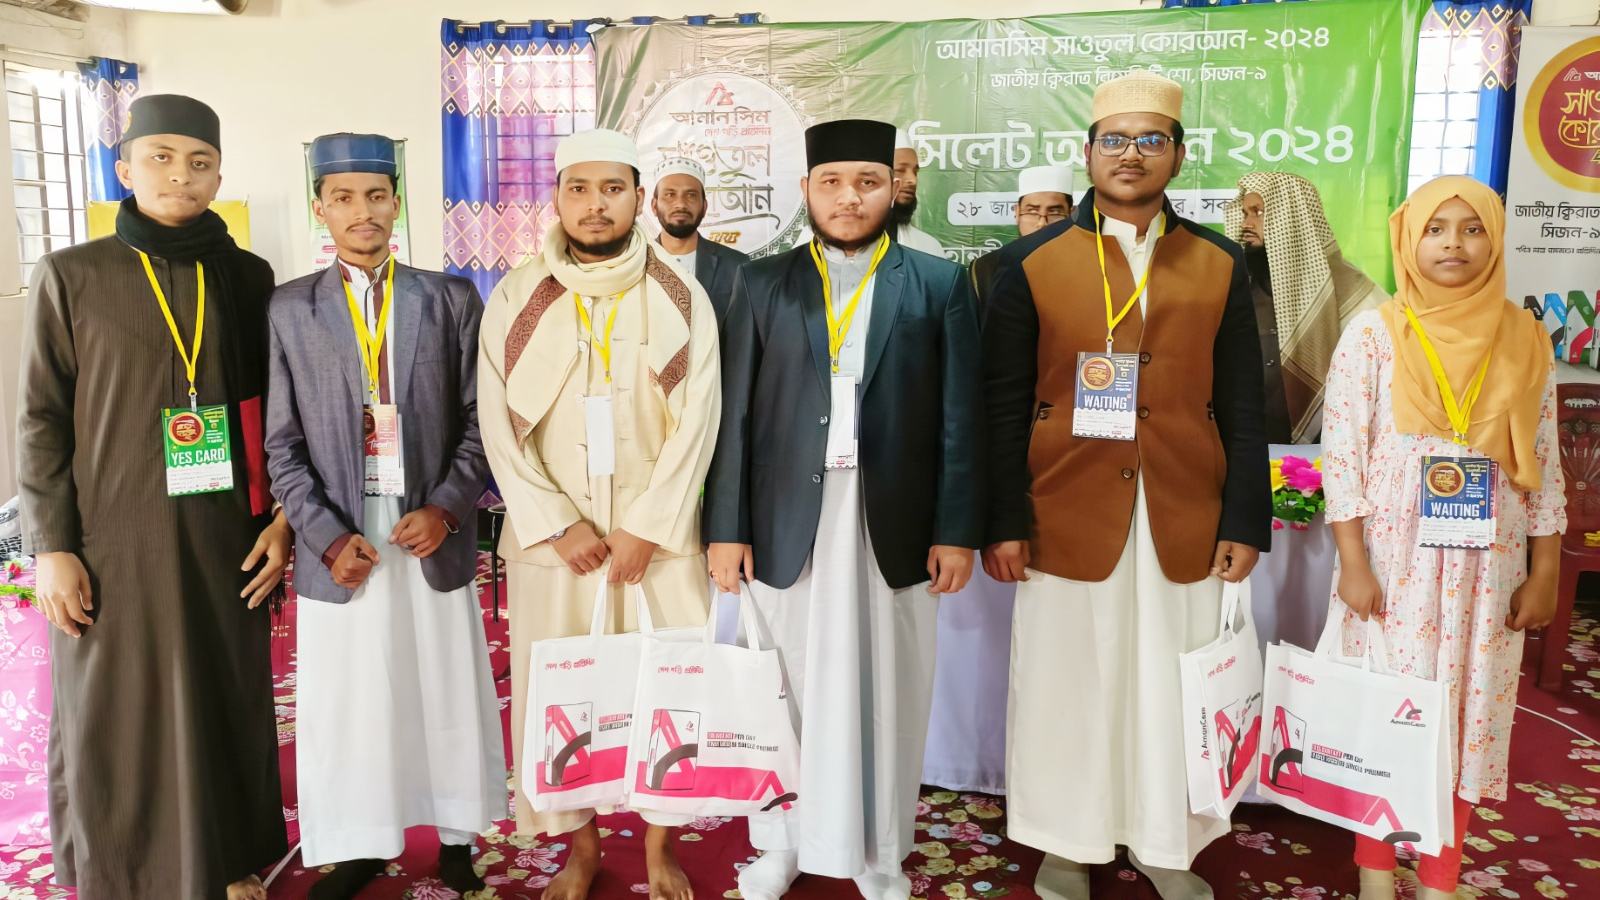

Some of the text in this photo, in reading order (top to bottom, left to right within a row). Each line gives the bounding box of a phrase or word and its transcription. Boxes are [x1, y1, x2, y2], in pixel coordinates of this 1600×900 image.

[936, 30, 1048, 59] আমানসিম
[1052, 34, 1136, 61] সাওতুল
[1264, 27, 1330, 49] ২০২৪
[991, 68, 1040, 89] জাতীয়
[1201, 62, 1267, 82] সিজন-৯
[908, 120, 1035, 170] সিলেট
[1228, 124, 1354, 166] ২০২৪
[957, 201, 982, 218] ২৮
[1515, 200, 1556, 218] জাতীয়
[1084, 395, 1128, 410] WAITING
[171, 447, 225, 465] YES CARD
[1430, 501, 1480, 517] WAITING
